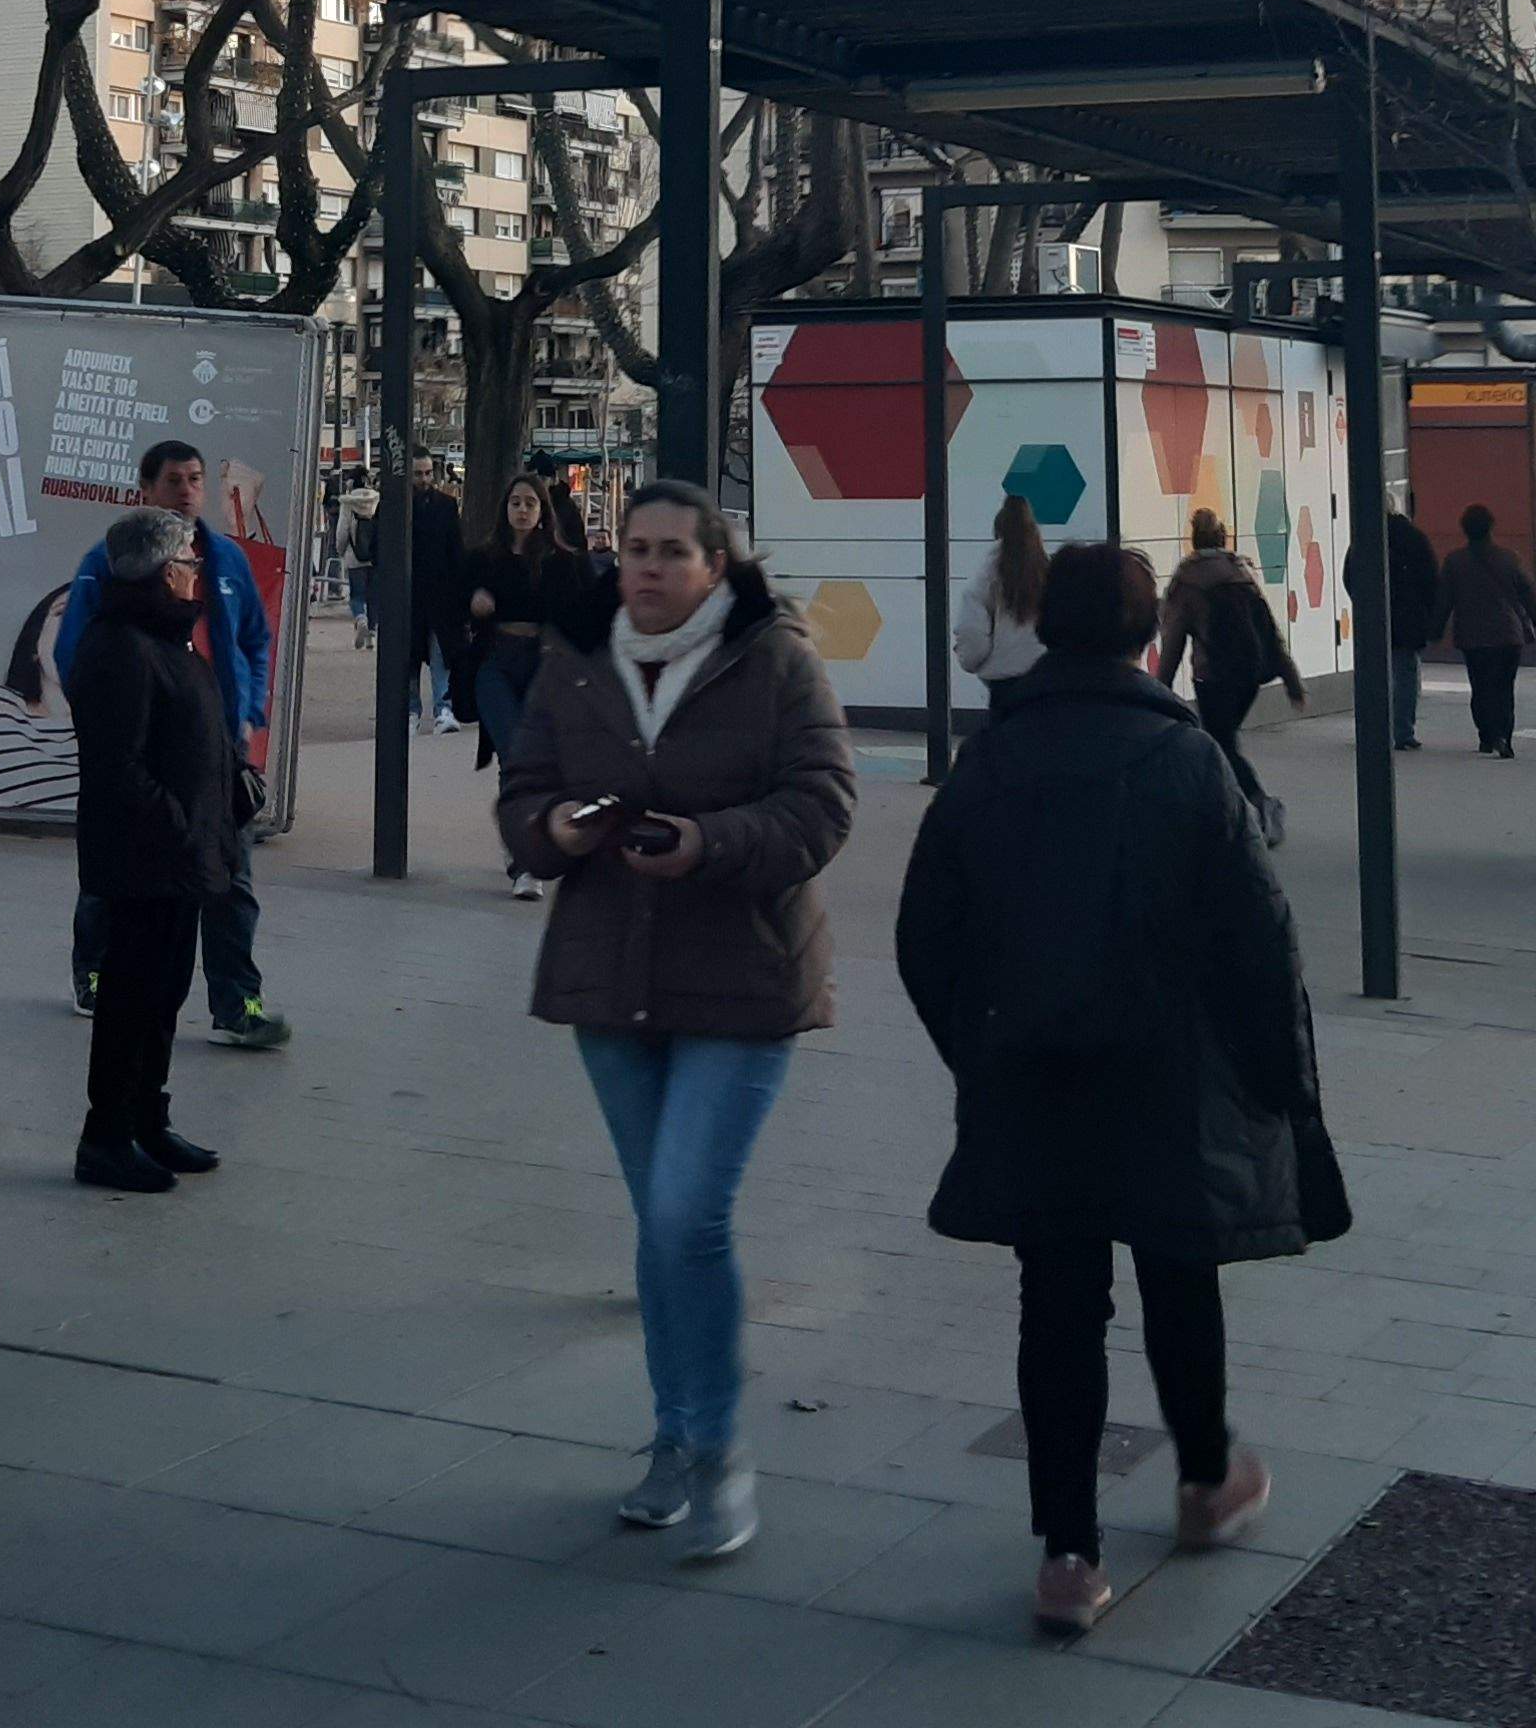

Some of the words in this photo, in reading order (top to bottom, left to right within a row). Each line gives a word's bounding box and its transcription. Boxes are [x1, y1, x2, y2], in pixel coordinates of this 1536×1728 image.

[64, 348, 132, 374] ADQUIREIX
[61, 370, 94, 391] VALS
[94, 374, 111, 393] DE
[56, 391, 65, 409] A
[67, 393, 115, 415] MEITAT
[115, 400, 133, 418] DE
[133, 402, 169, 423] PREU.
[53, 413, 107, 436] COMPRA
[107, 420, 117, 438] A
[119, 422, 134, 441] LA
[50, 434, 81, 453] TEVA
[44, 455, 77, 477] RUBÍ
[41, 477, 146, 506] RUBISHOVAL.CA
